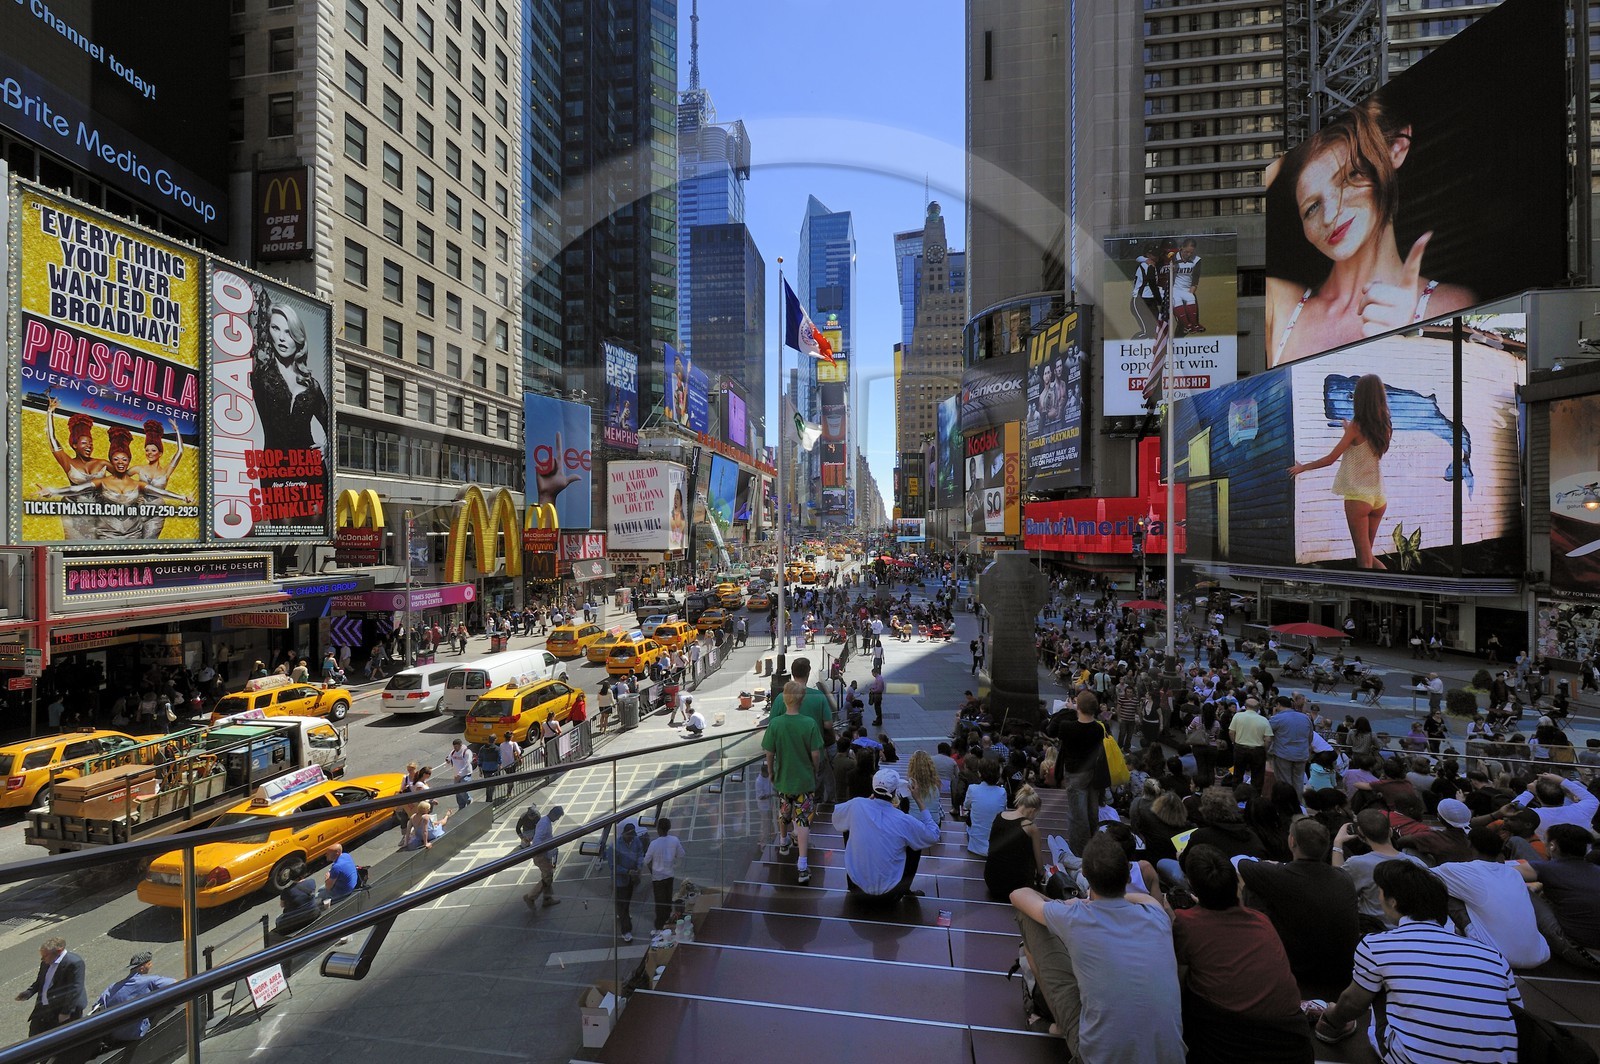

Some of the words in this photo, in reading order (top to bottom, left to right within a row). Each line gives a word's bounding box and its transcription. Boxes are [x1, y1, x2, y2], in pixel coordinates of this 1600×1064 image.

[30, 0, 104, 64] Channel
[108, 54, 157, 101] today!
[76, 121, 151, 186] Media
[155, 168, 217, 224] Group
[266, 214, 299, 226] OPEN
[270, 225, 296, 241] 24
[262, 241, 303, 253] HOURS
[60, 239, 109, 280] YOU
[115, 258, 170, 298] EVER
[47, 262, 146, 316] WANTED
[151, 295, 180, 325] ON
[1030, 312, 1078, 369] UFC
[1120, 343, 1152, 359] Help
[1172, 340, 1219, 357] injured
[22, 319, 198, 412] PRISCILLA
[1188, 356, 1218, 369] win.
[606, 360, 637, 385] BEST
[606, 375, 637, 394] MUSICAL
[21, 366, 81, 391] QUEEN
[87, 385, 109, 398] OF
[114, 392, 141, 408] THE
[146, 401, 197, 423] DESERT
[213, 268, 256, 539] CHICAGO
[102, 404, 150, 422] musical
[604, 426, 639, 445] MEMPHIS
[969, 427, 1000, 456] Kodak
[244, 449, 322, 468] DROP-DEAD
[1056, 448, 1067, 457] MAY
[1068, 446, 1076, 454] 28
[246, 465, 323, 480] GORGEOUS
[611, 472, 625, 483] YOU
[628, 467, 659, 480] ALREADY
[1006, 452, 1019, 507] Kodak
[248, 483, 325, 506] CHRISTIE
[625, 480, 647, 492] KNOW
[640, 489, 664, 500] GONNA
[24, 501, 125, 517] TICKETMASTER.COM
[140, 503, 199, 518] 877-250-2929
[250, 500, 325, 523] BRINKLEY
[624, 502, 643, 514] LOVE
[614, 520, 643, 535] MAMMA
[644, 518, 662, 531] MIA!
[1026, 517, 1049, 536] Bank
[1053, 517, 1066, 535] of
[337, 533, 379, 542] McDonald's
[68, 567, 154, 592] PRISCILLA
[155, 565, 191, 575] QUEEN
[193, 563, 208, 573] OF
[209, 561, 228, 572] THE
[230, 561, 265, 571] DESERT
[295, 584, 330, 597] CHANGE
[331, 582, 357, 593] GROUP
[427, 597, 443, 605] CENTER
[250, 614, 282, 626] MUSICAL
